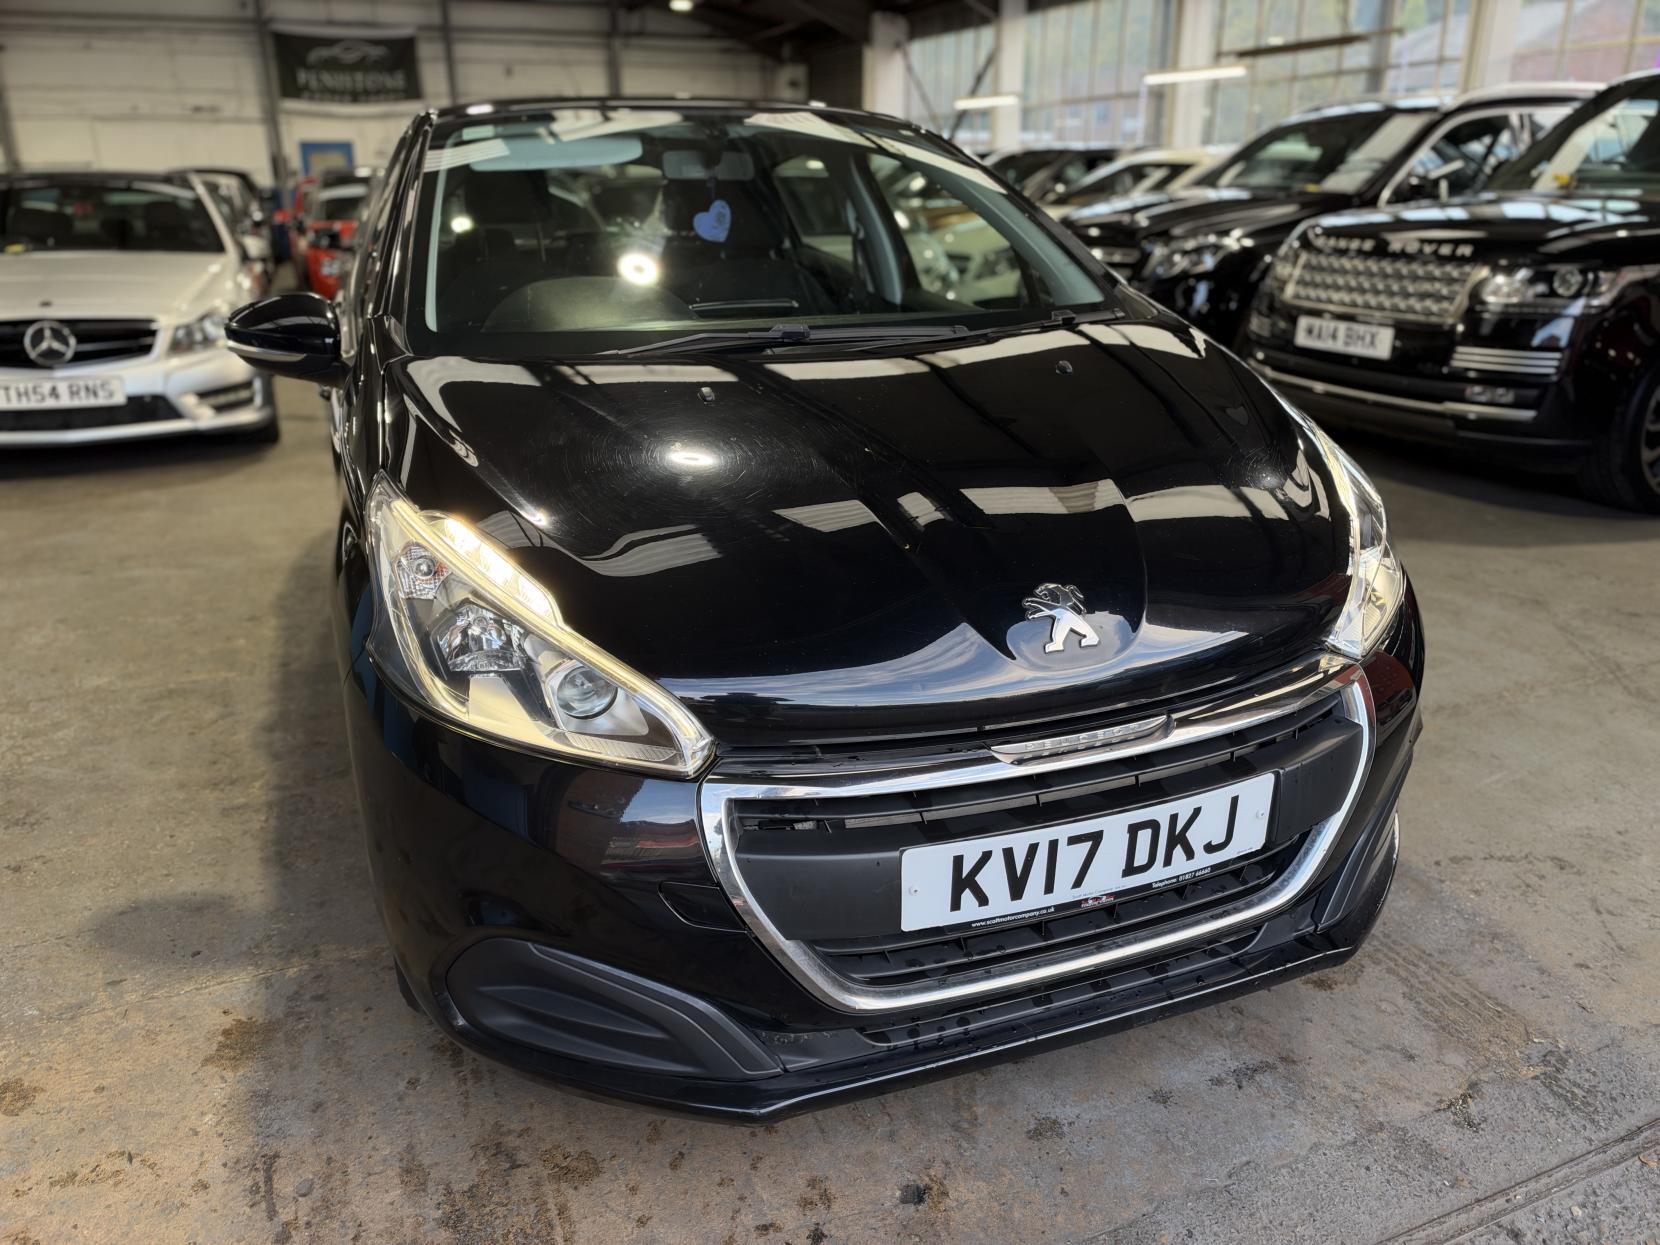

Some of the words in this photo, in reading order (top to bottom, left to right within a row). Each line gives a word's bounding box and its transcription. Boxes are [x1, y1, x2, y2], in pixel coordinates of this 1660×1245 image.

[1388, 239, 1475, 257] ROVER
[67, 381, 115, 401] RNS
[949, 829, 1104, 912] KV17
[1121, 795, 1239, 878] DKJ
